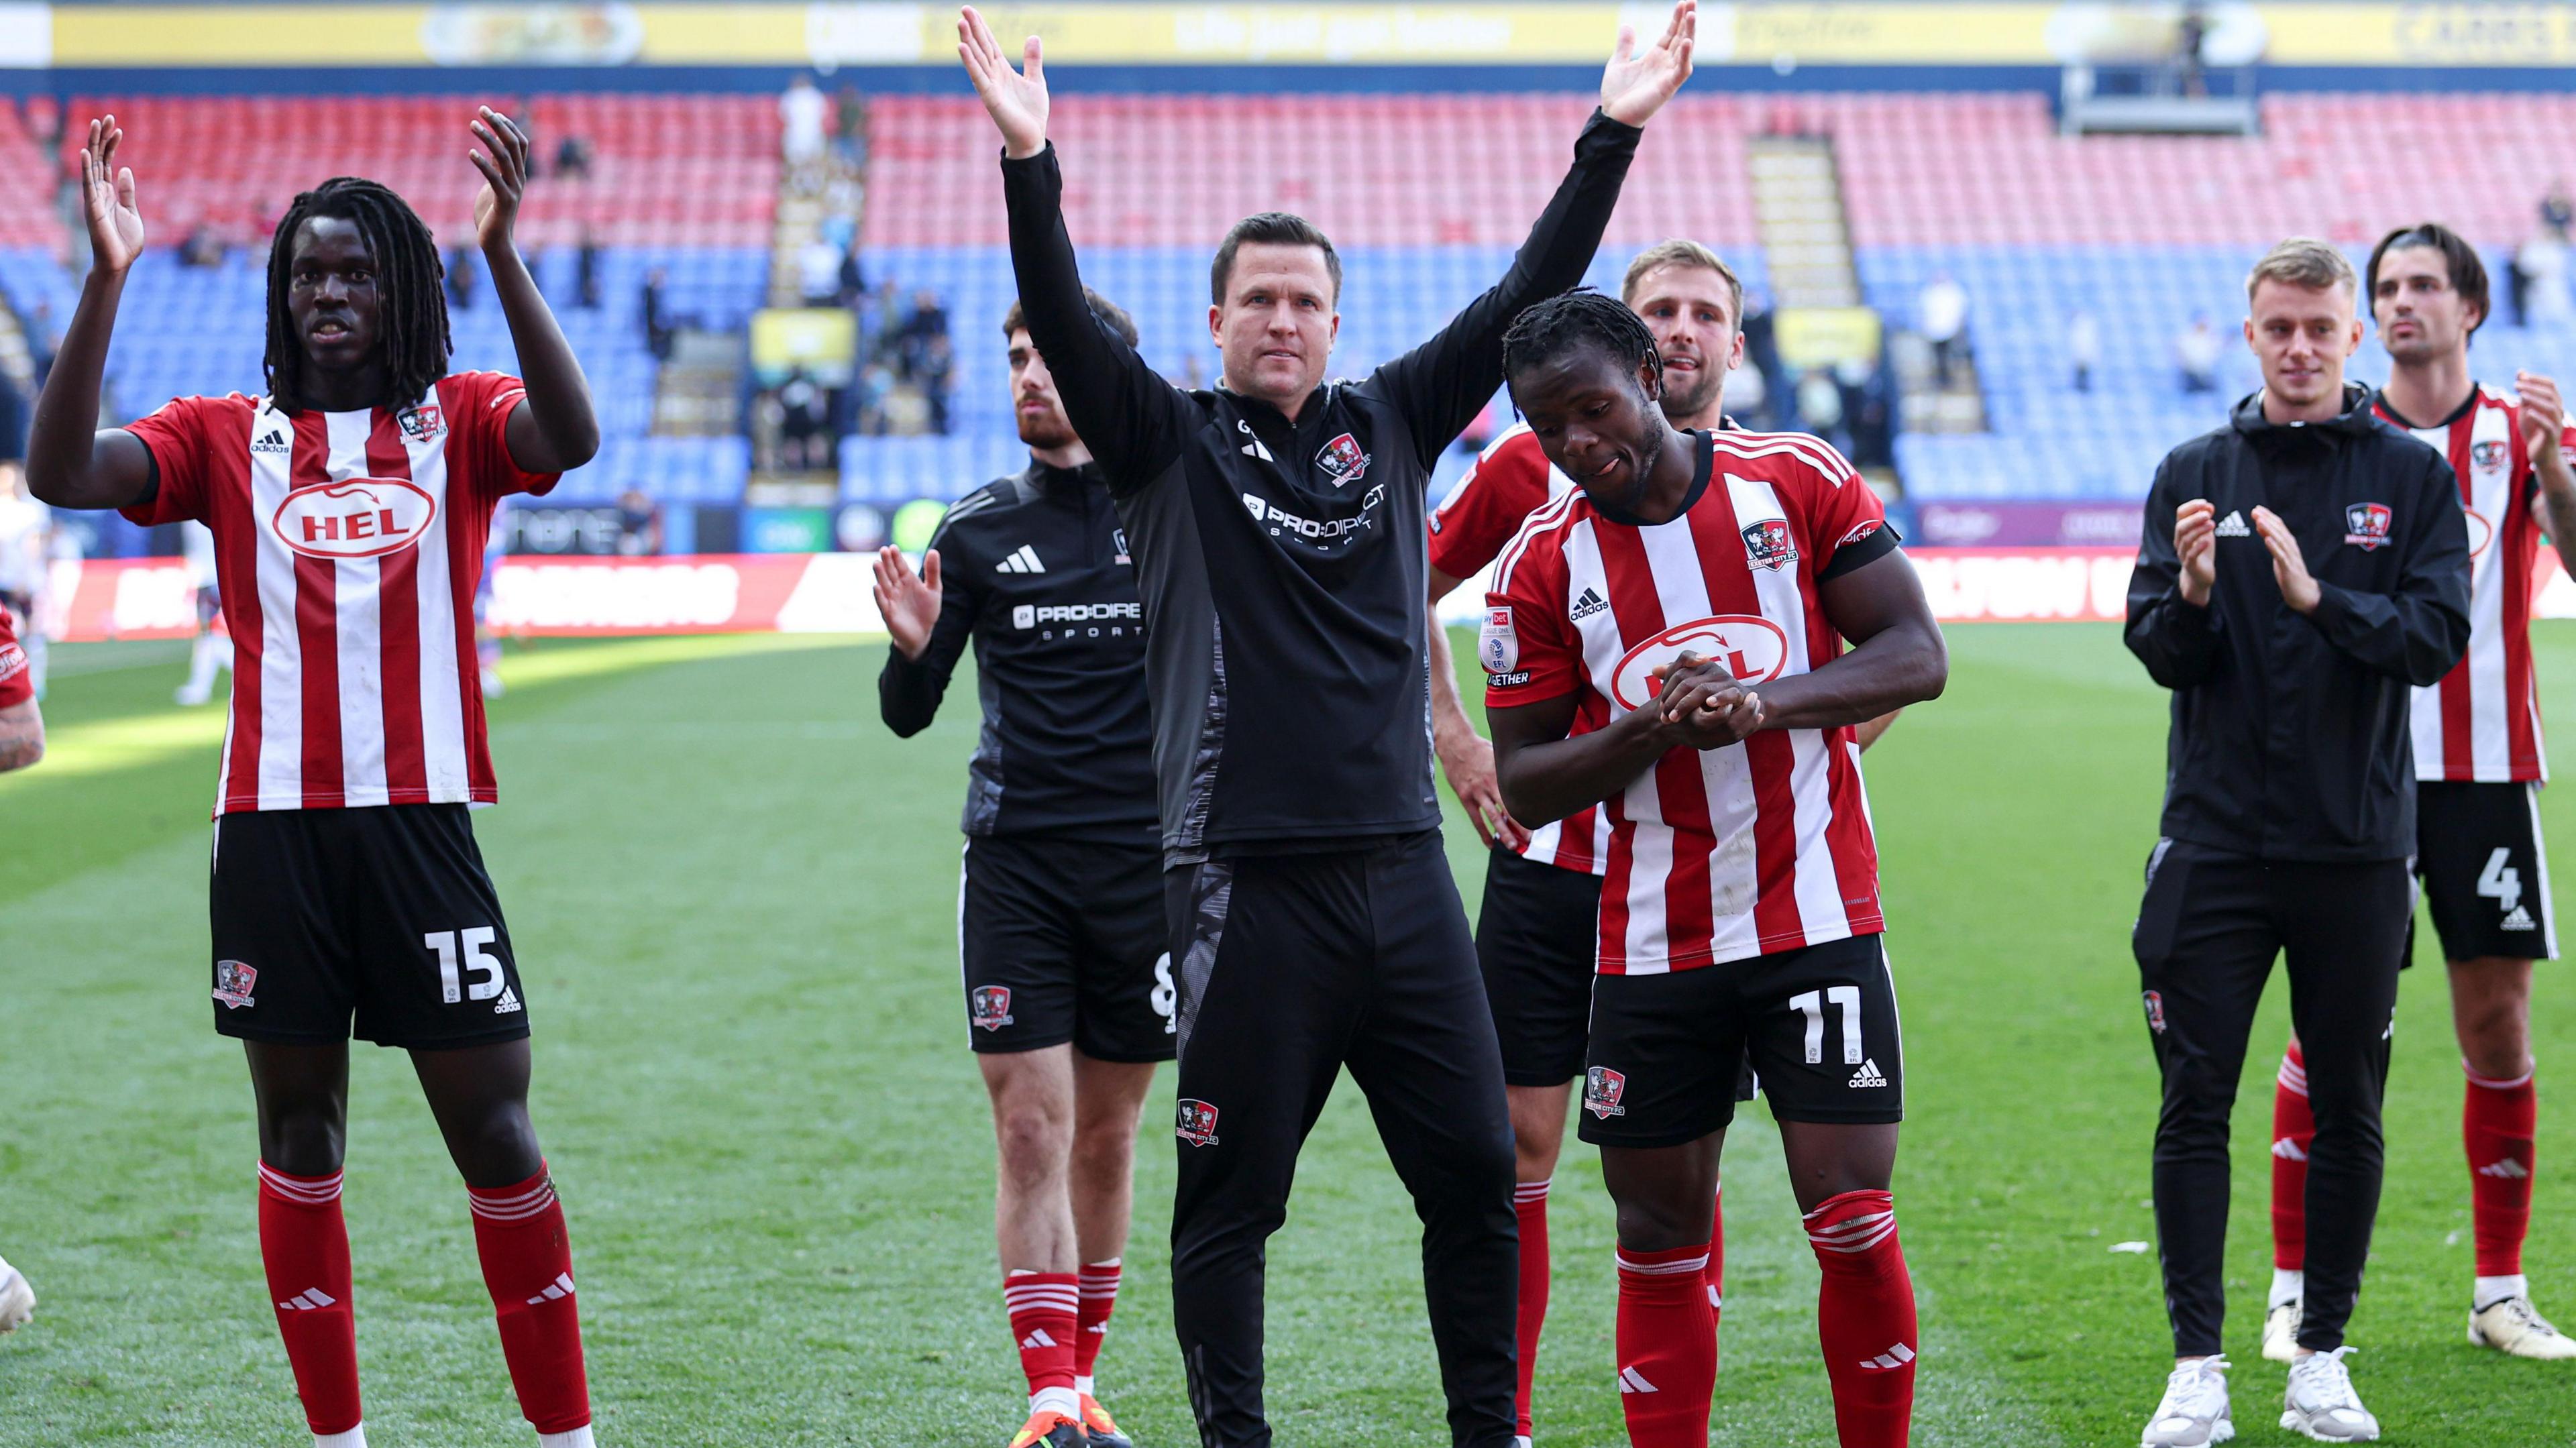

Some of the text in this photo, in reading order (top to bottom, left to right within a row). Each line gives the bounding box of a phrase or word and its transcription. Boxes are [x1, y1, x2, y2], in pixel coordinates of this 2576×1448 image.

[251, 445, 289, 453] adidas
[302, 508, 411, 542] HEL
[1270, 519, 1371, 551] SOT
[1750, 557, 1774, 567] EXETER
[1494, 612, 1507, 622] bet
[1570, 601, 1609, 620] adidas
[1042, 626, 1143, 641] SPORT
[1493, 660, 1507, 668] EFL
[2477, 846, 2522, 911] 4
[424, 926, 505, 1004] 15
[1150, 951, 1177, 1017] 8
[494, 1002, 522, 1014] adidas
[1788, 985, 1863, 1064] 11
[1848, 1076, 1887, 1088] adidas
